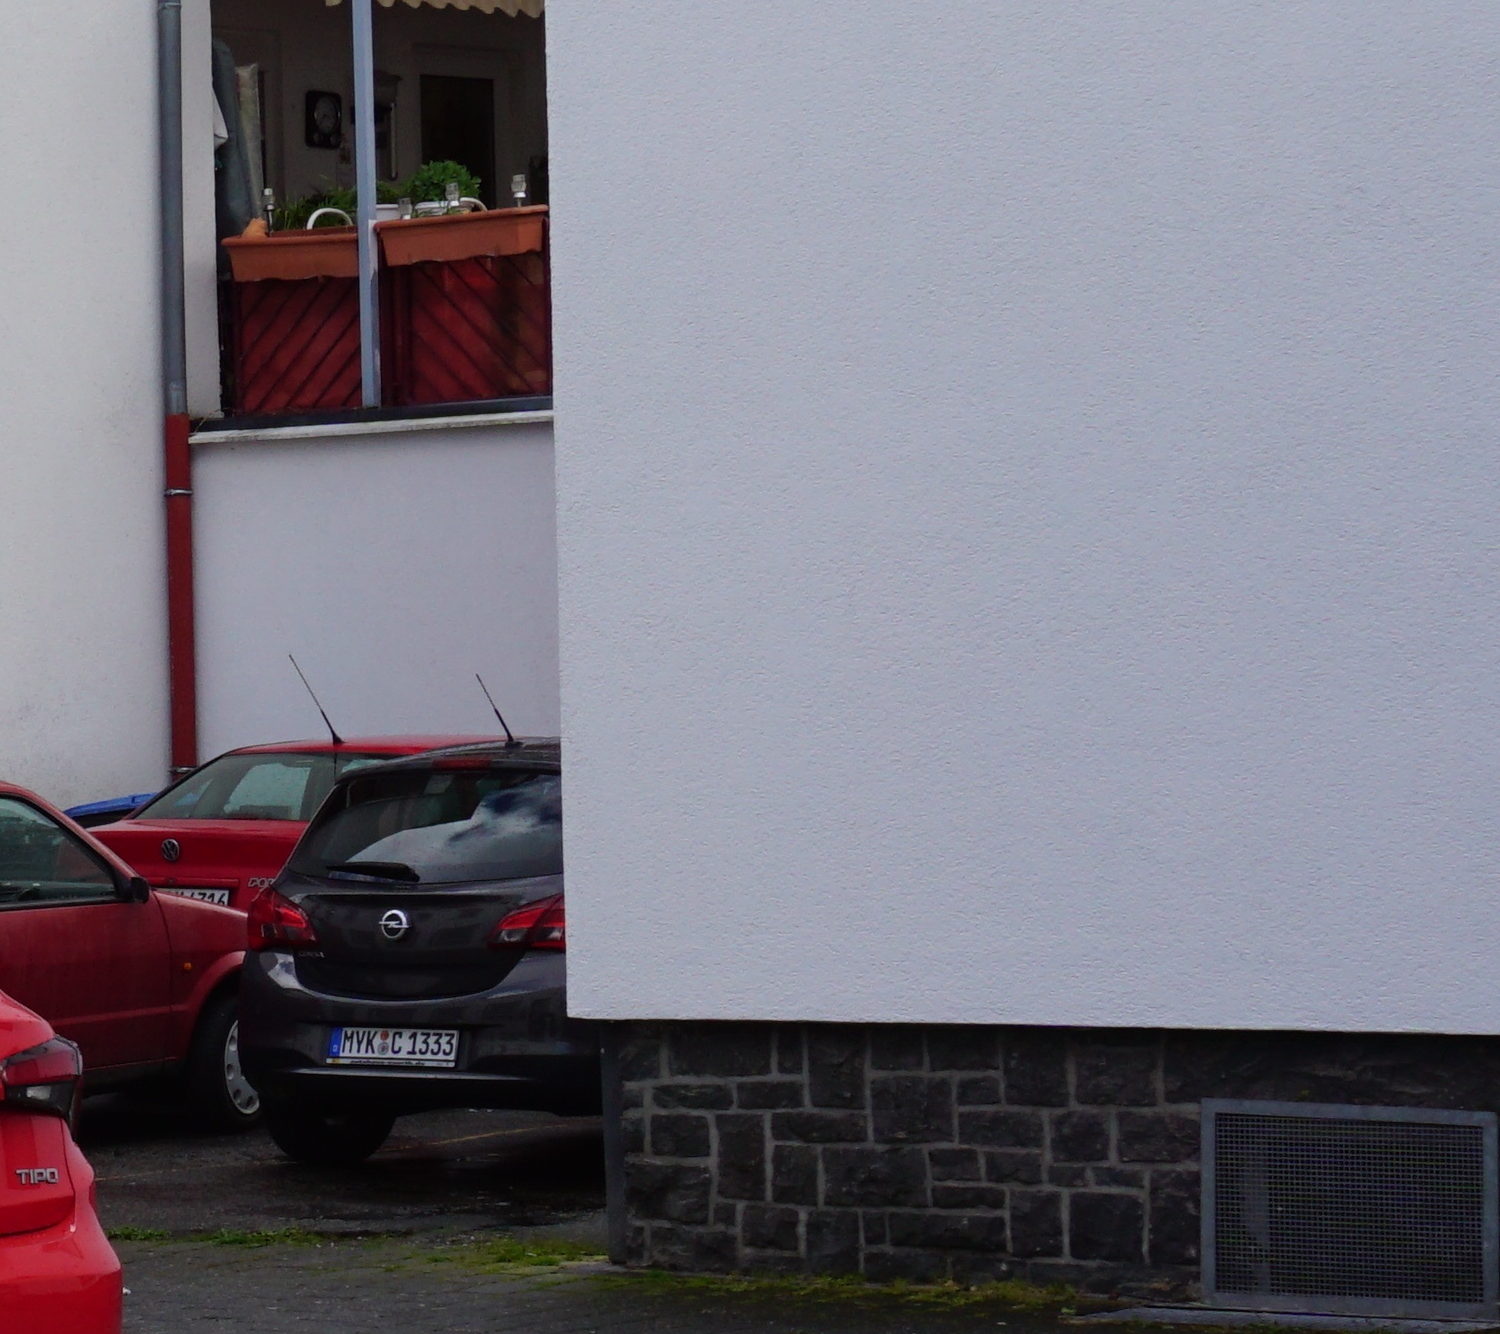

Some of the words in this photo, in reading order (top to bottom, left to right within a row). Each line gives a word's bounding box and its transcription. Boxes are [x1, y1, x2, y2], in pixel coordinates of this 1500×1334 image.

[342, 1030, 377, 1054] MYK
[391, 1031, 402, 1055] C
[406, 1032, 456, 1056] 1333
[15, 1168, 60, 1185] TIPO
